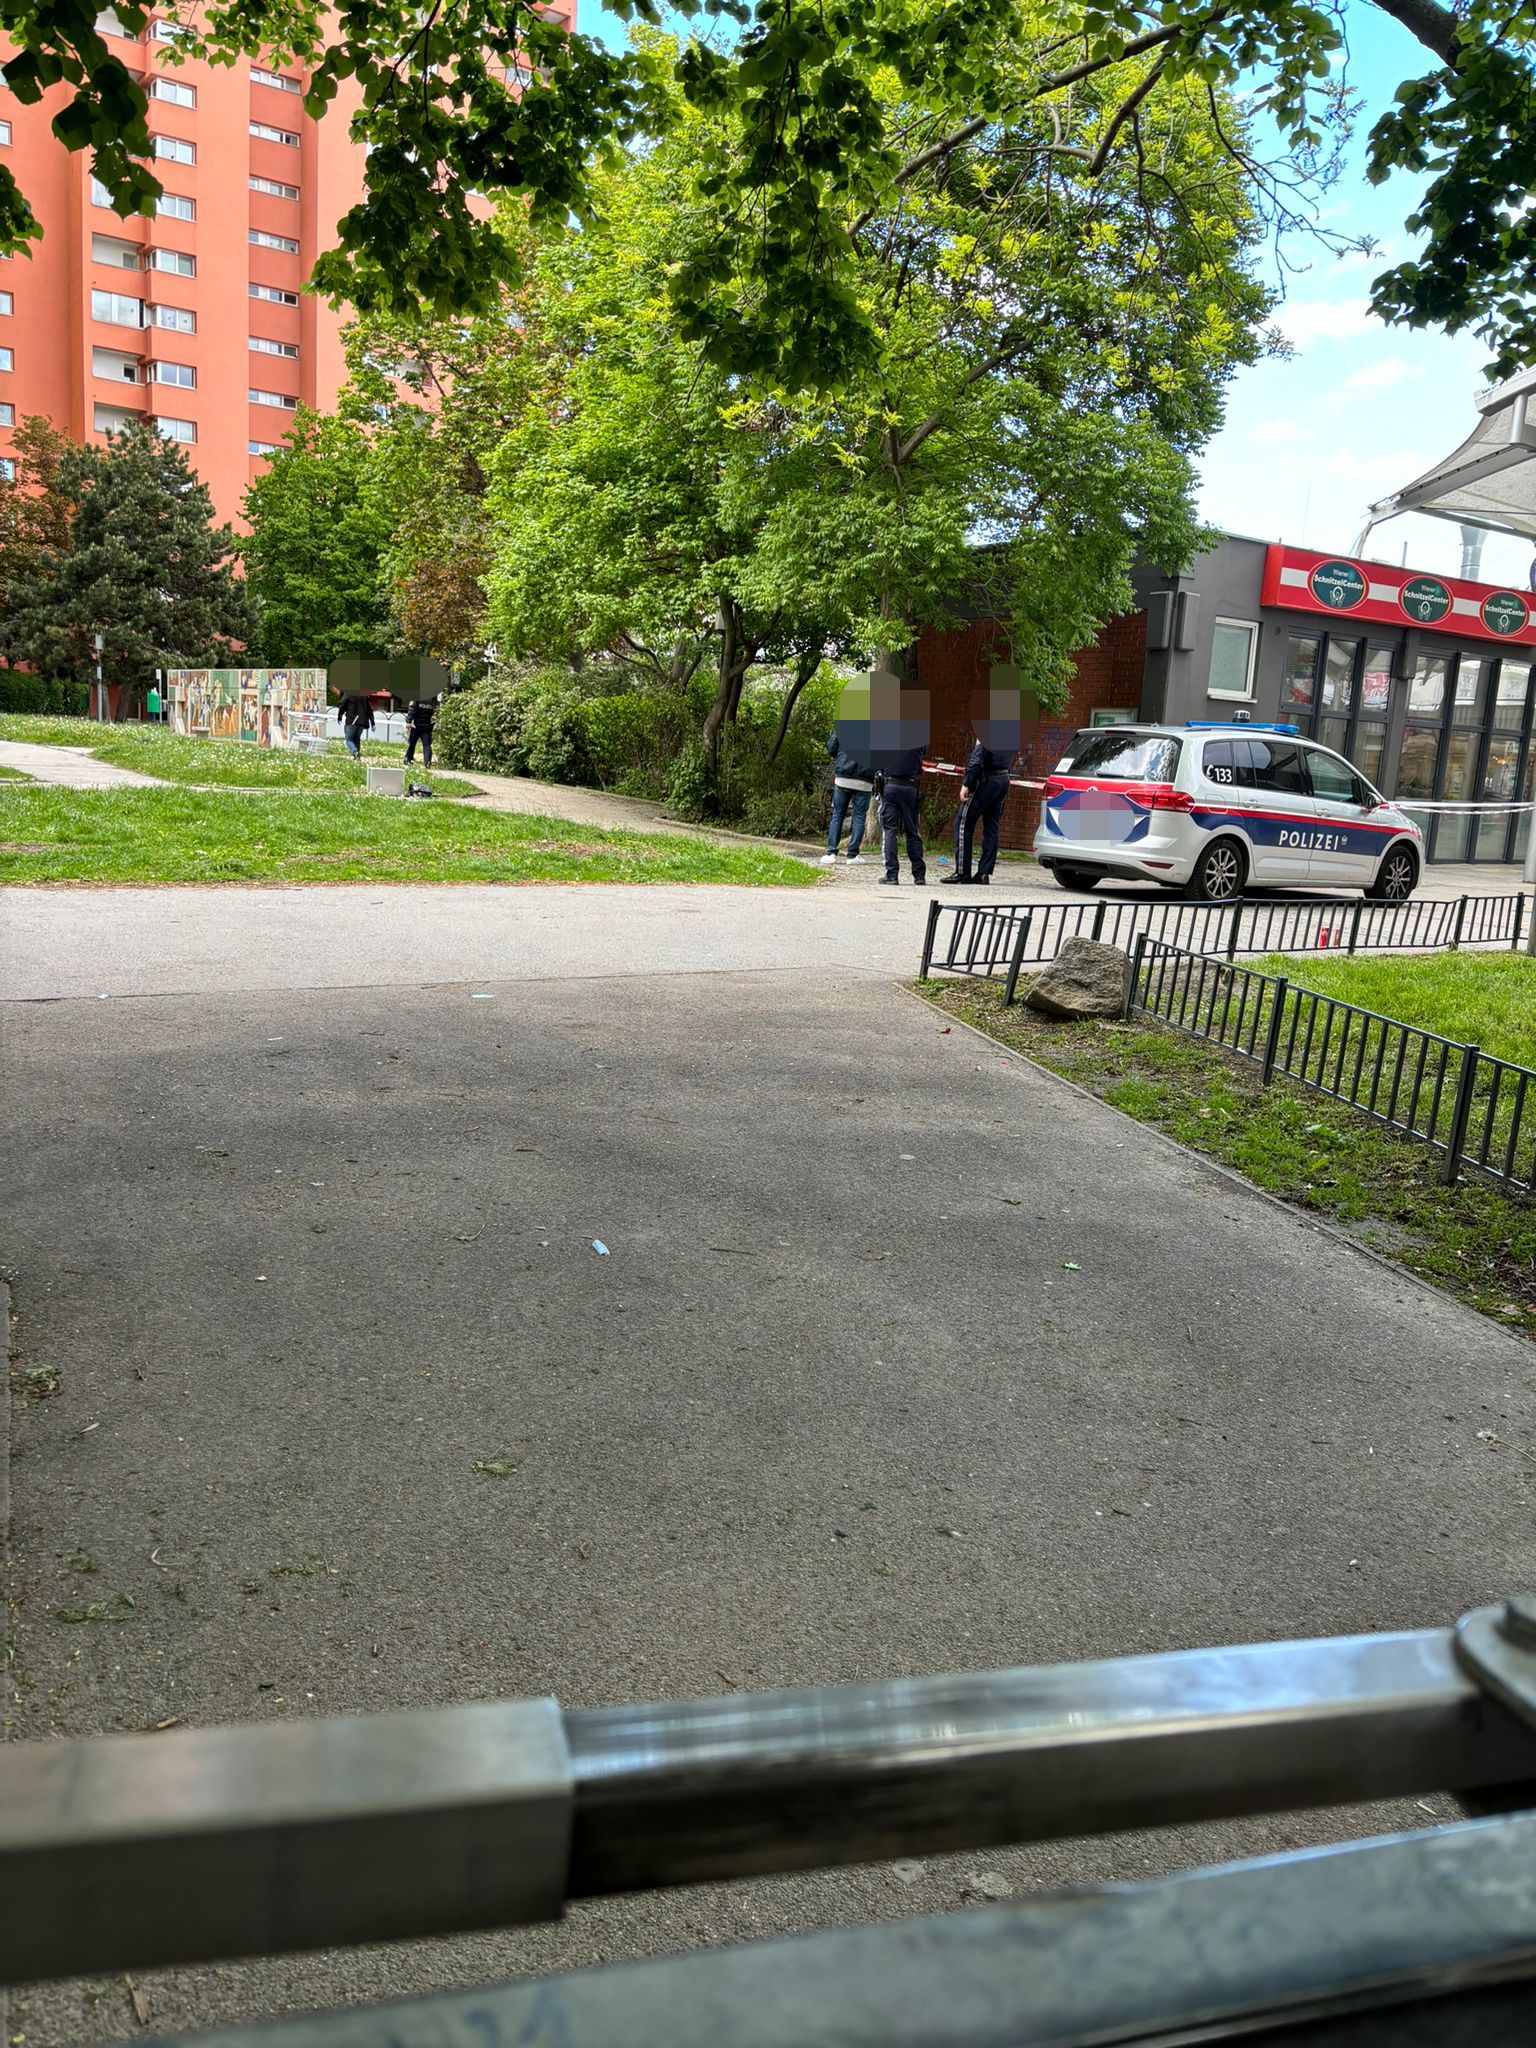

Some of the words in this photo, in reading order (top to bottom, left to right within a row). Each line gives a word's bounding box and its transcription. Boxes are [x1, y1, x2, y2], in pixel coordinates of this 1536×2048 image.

[1314, 574, 1364, 590] SchnitzelCenter
[1403, 590, 1449, 605] SchnitzelCenter
[1214, 767, 1233, 783] 133
[1278, 829, 1339, 851] POLIZEI
